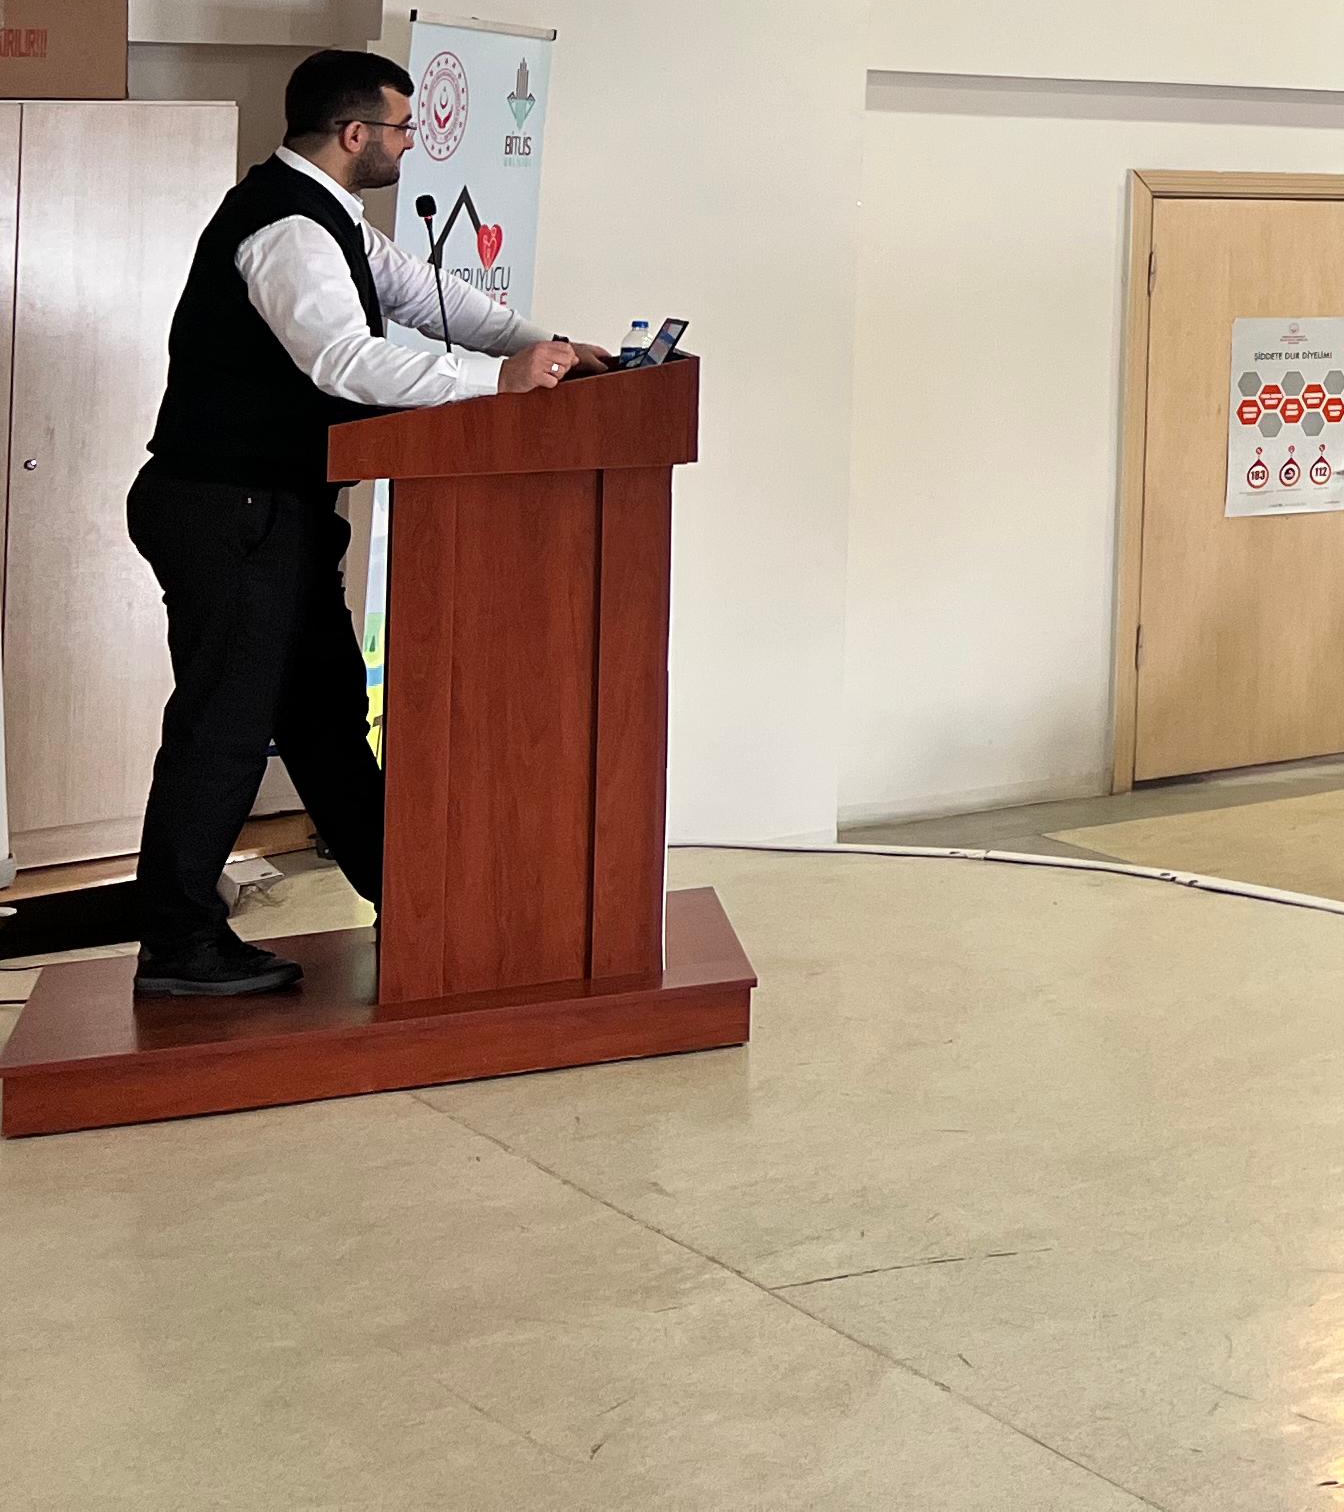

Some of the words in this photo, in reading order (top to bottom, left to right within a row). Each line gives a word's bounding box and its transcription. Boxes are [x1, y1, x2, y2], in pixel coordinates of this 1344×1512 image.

[447, 266, 511, 291] RUYUCU
[1285, 352, 1300, 360] DUR
[1251, 470, 1265, 480] 183
[1314, 467, 1327, 476] 112
